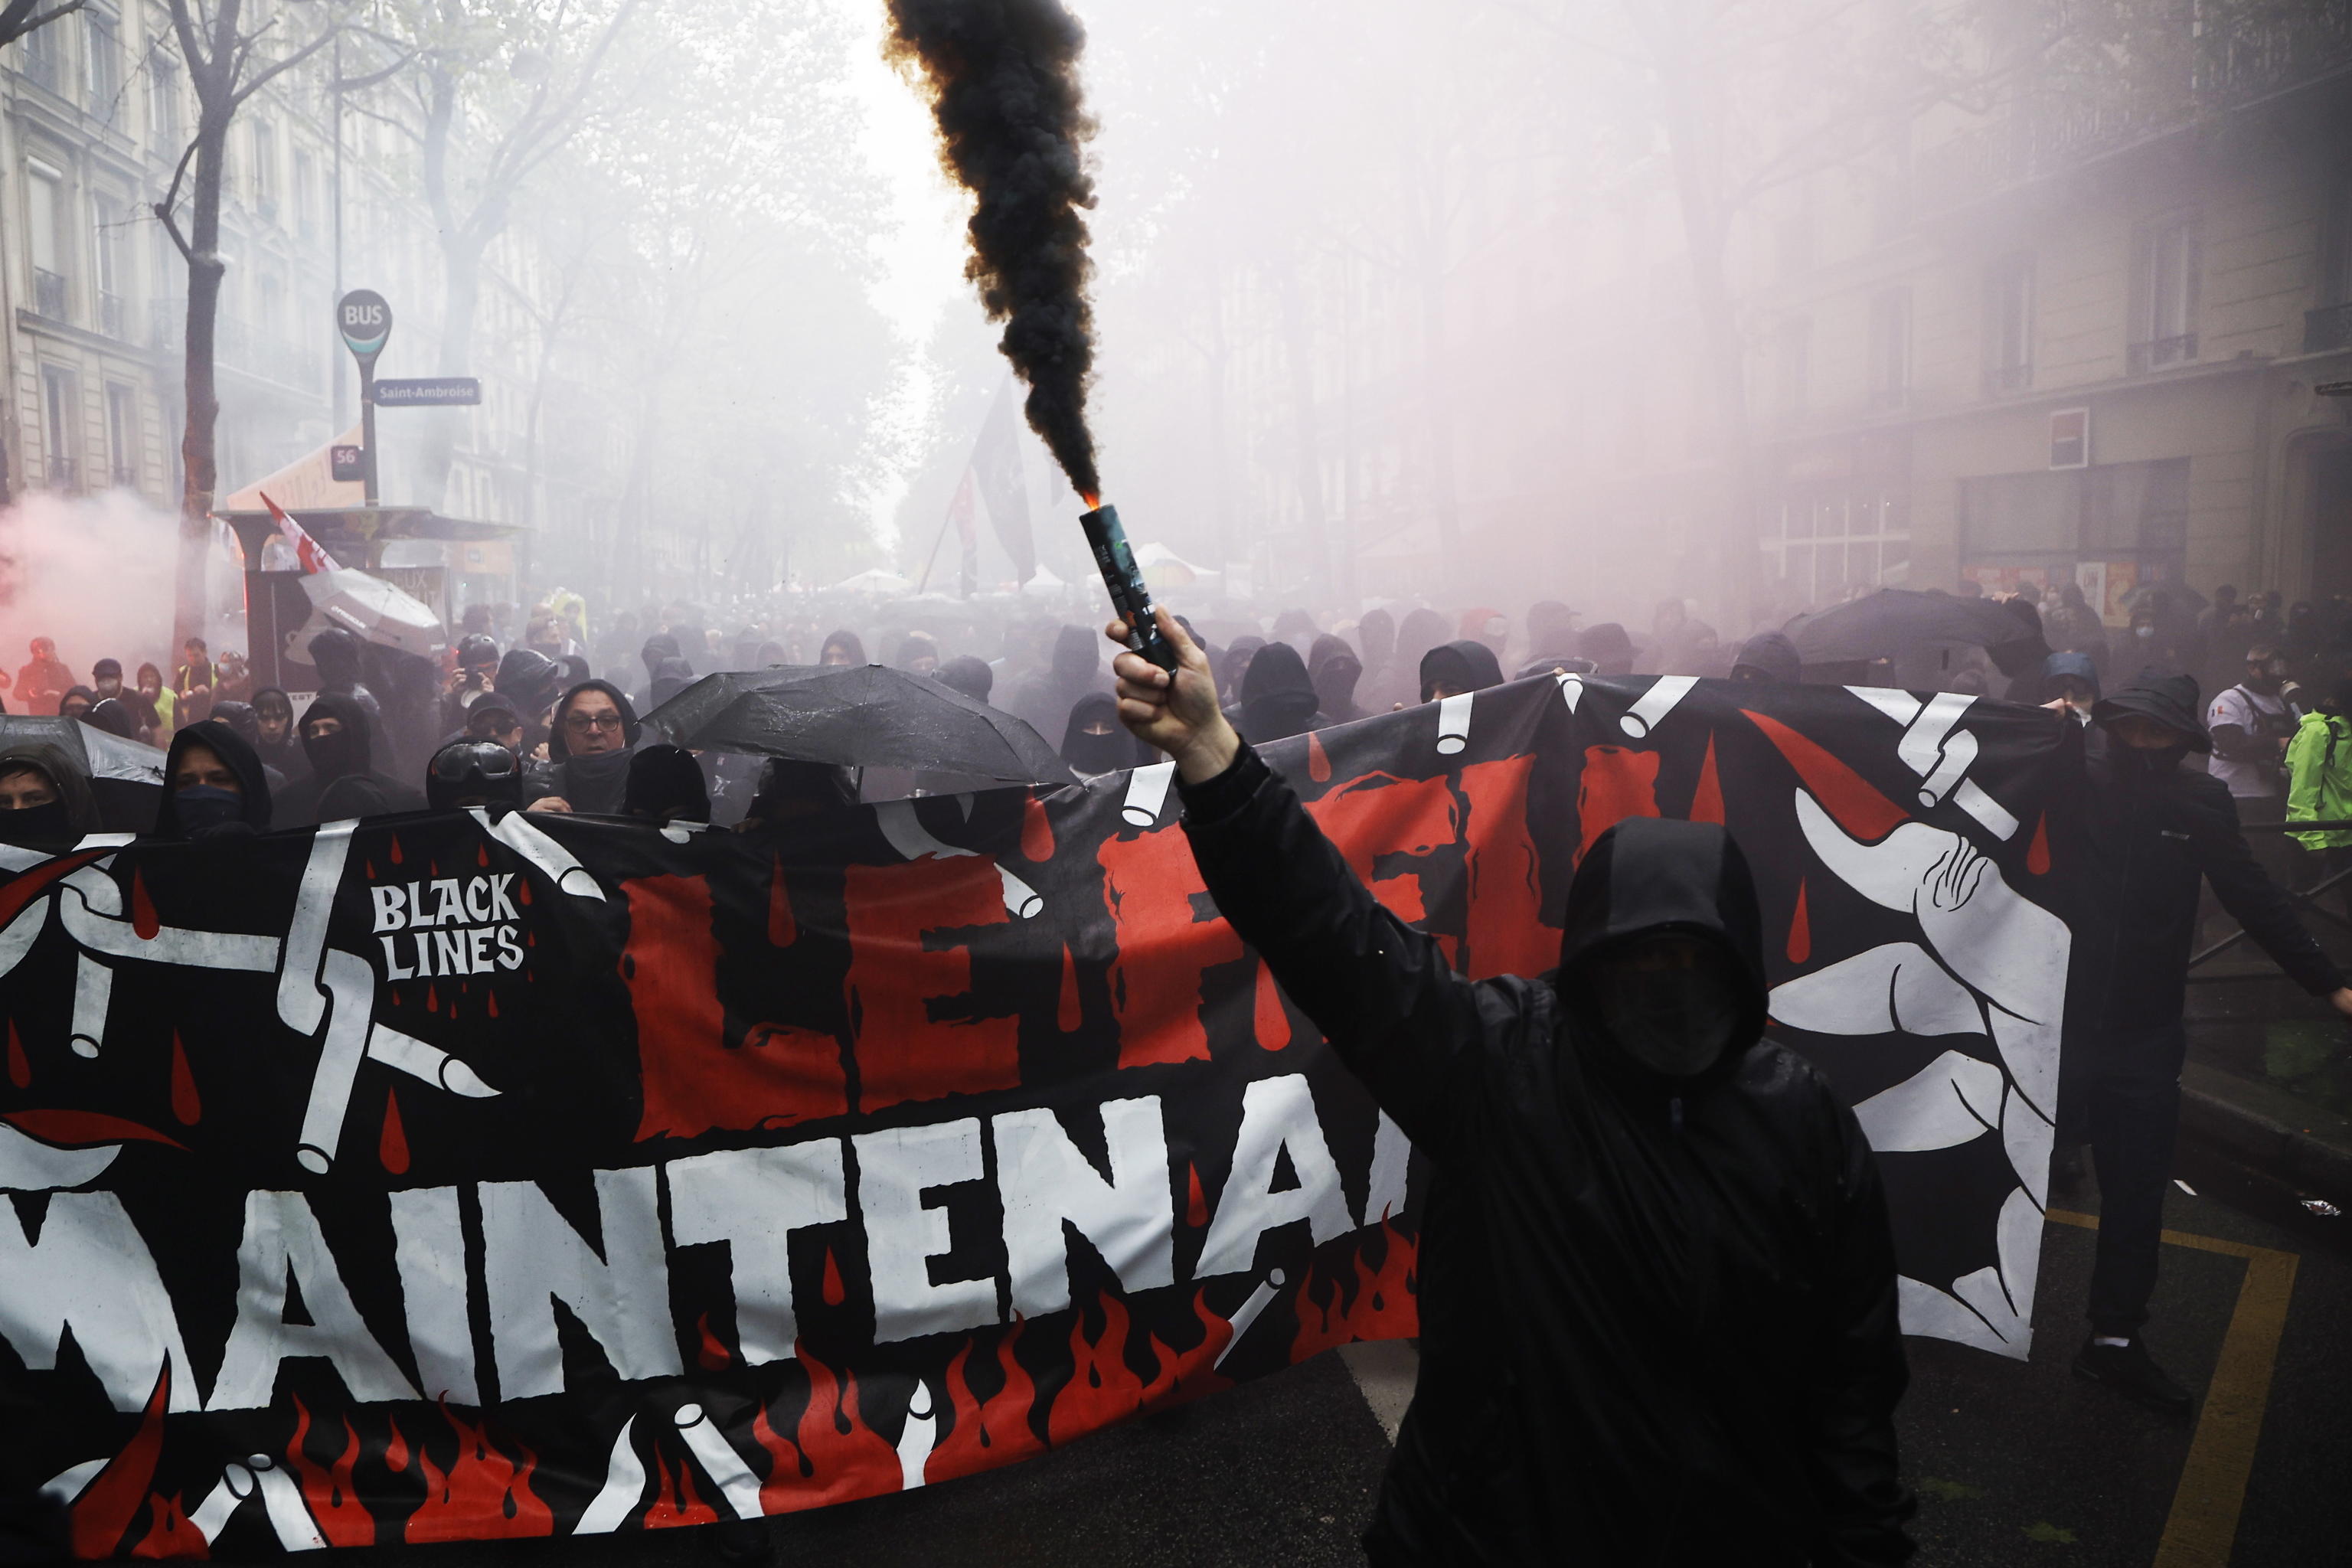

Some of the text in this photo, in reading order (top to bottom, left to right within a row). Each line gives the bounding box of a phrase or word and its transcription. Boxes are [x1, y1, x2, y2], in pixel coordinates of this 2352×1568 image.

[345, 305, 382, 325] BUS
[380, 384, 474, 399] Saint-Ambroise
[337, 450, 355, 463] 56
[371, 872, 521, 934] BLACK
[378, 924, 524, 982] LINES
[616, 851, 1022, 1143] LE
